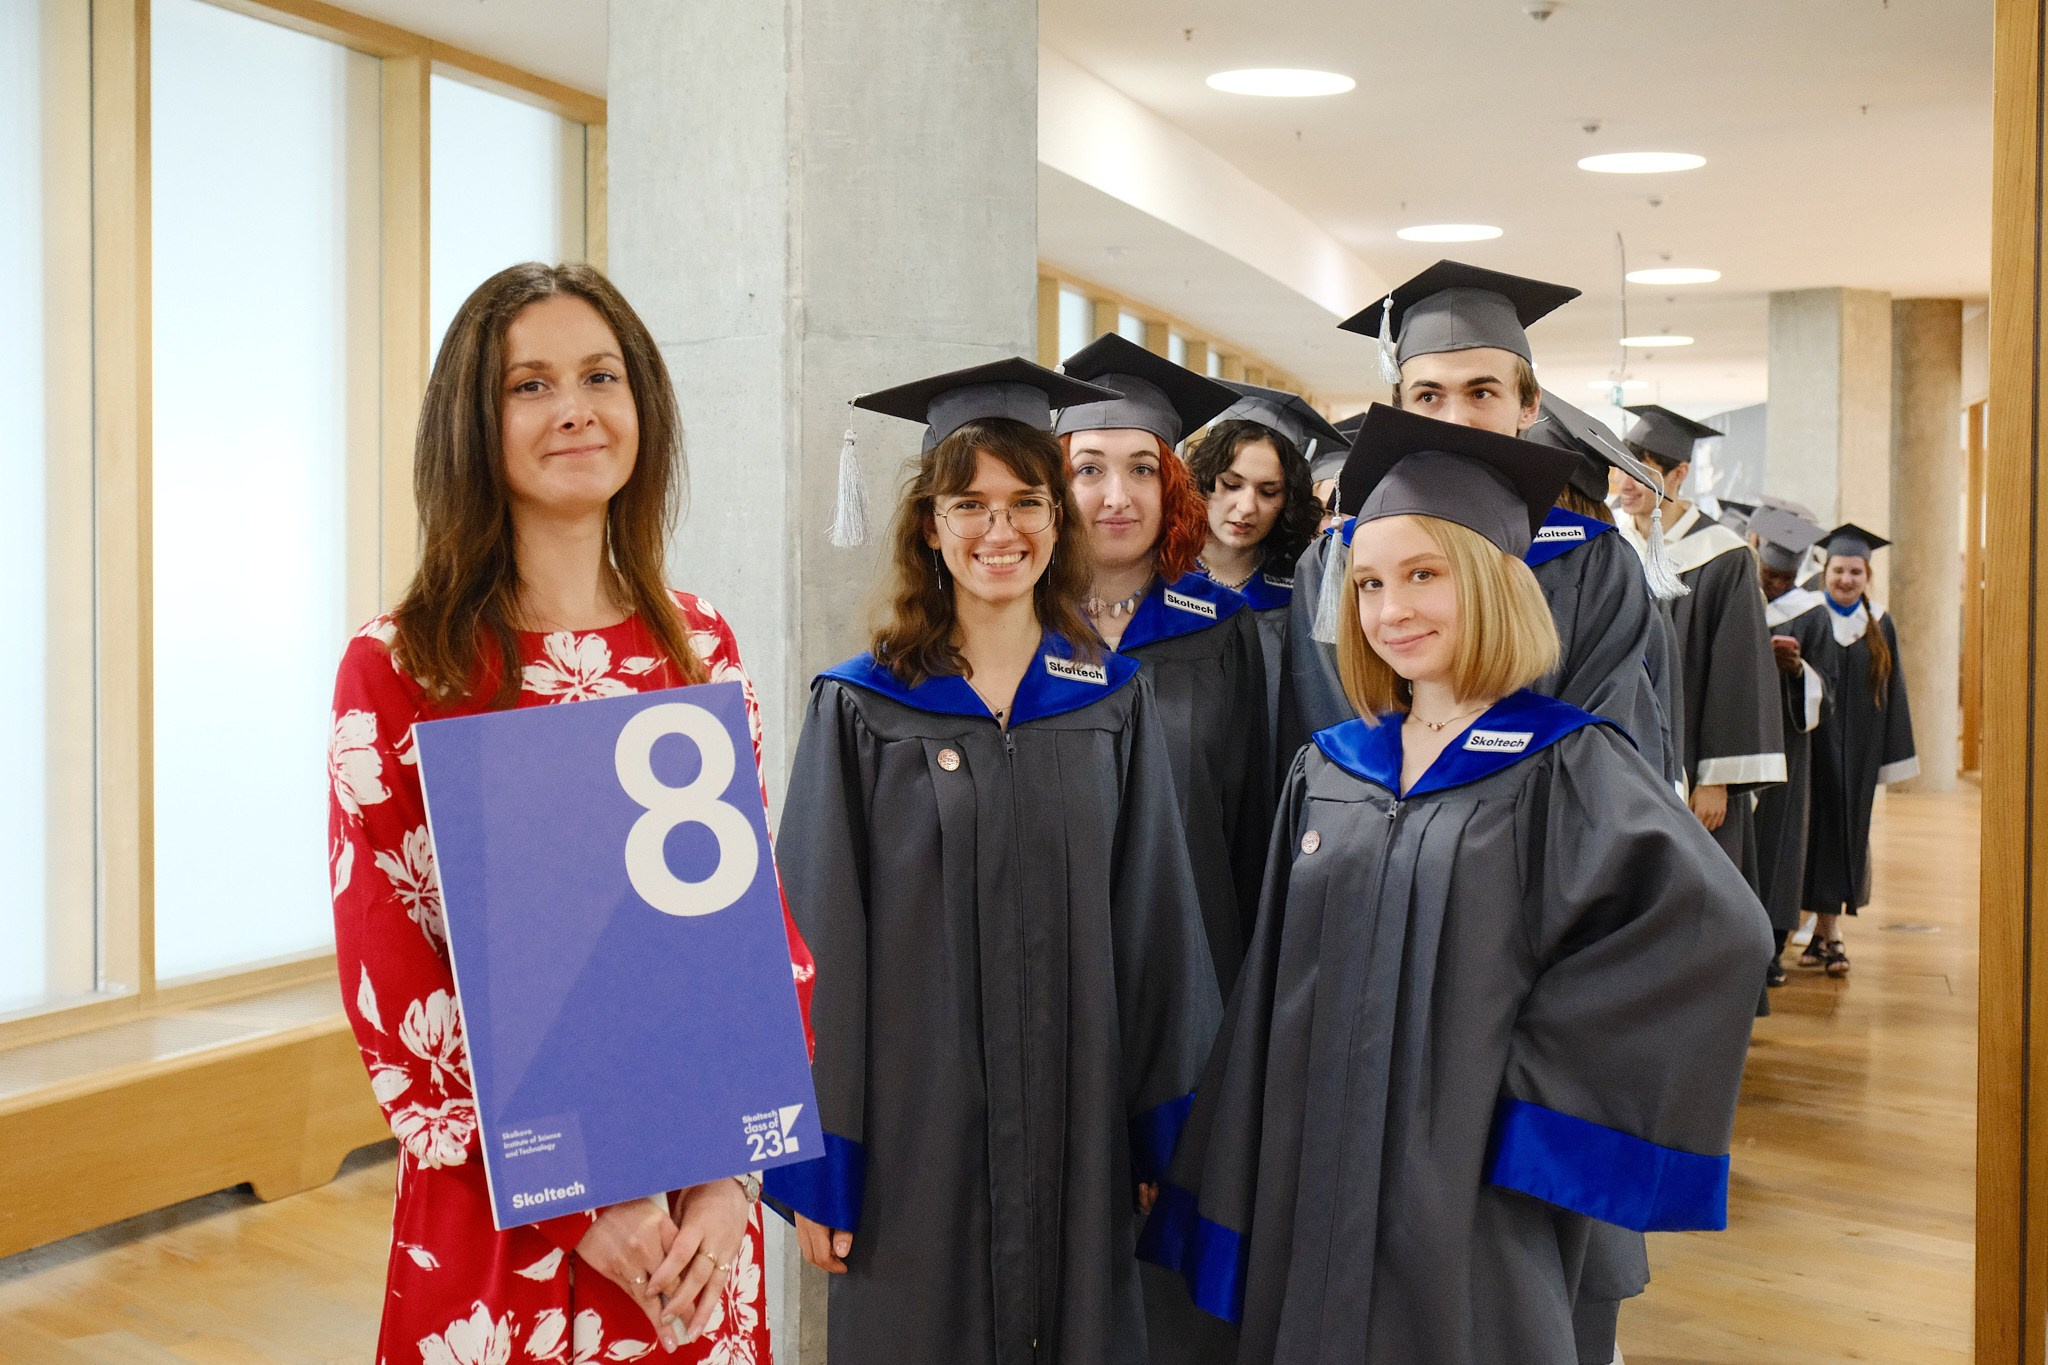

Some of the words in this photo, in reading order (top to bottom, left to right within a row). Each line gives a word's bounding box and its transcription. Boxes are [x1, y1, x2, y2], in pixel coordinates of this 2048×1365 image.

[1537, 530, 1582, 538] koltech
[1167, 594, 1213, 614] Skoltech
[1049, 661, 1103, 679] Skoltech
[1470, 735, 1525, 748] Skoltech
[615, 703, 758, 917] 8
[742, 1109, 778, 1124] Skoltech
[744, 1122, 768, 1134] class
[768, 1116, 779, 1128] of
[503, 1139, 529, 1149] Institute
[530, 1135, 537, 1144] of
[537, 1132, 562, 1142] Science
[505, 1149, 519, 1158] and
[519, 1143, 556, 1156] Technology
[512, 1181, 585, 1208] Skoltech
